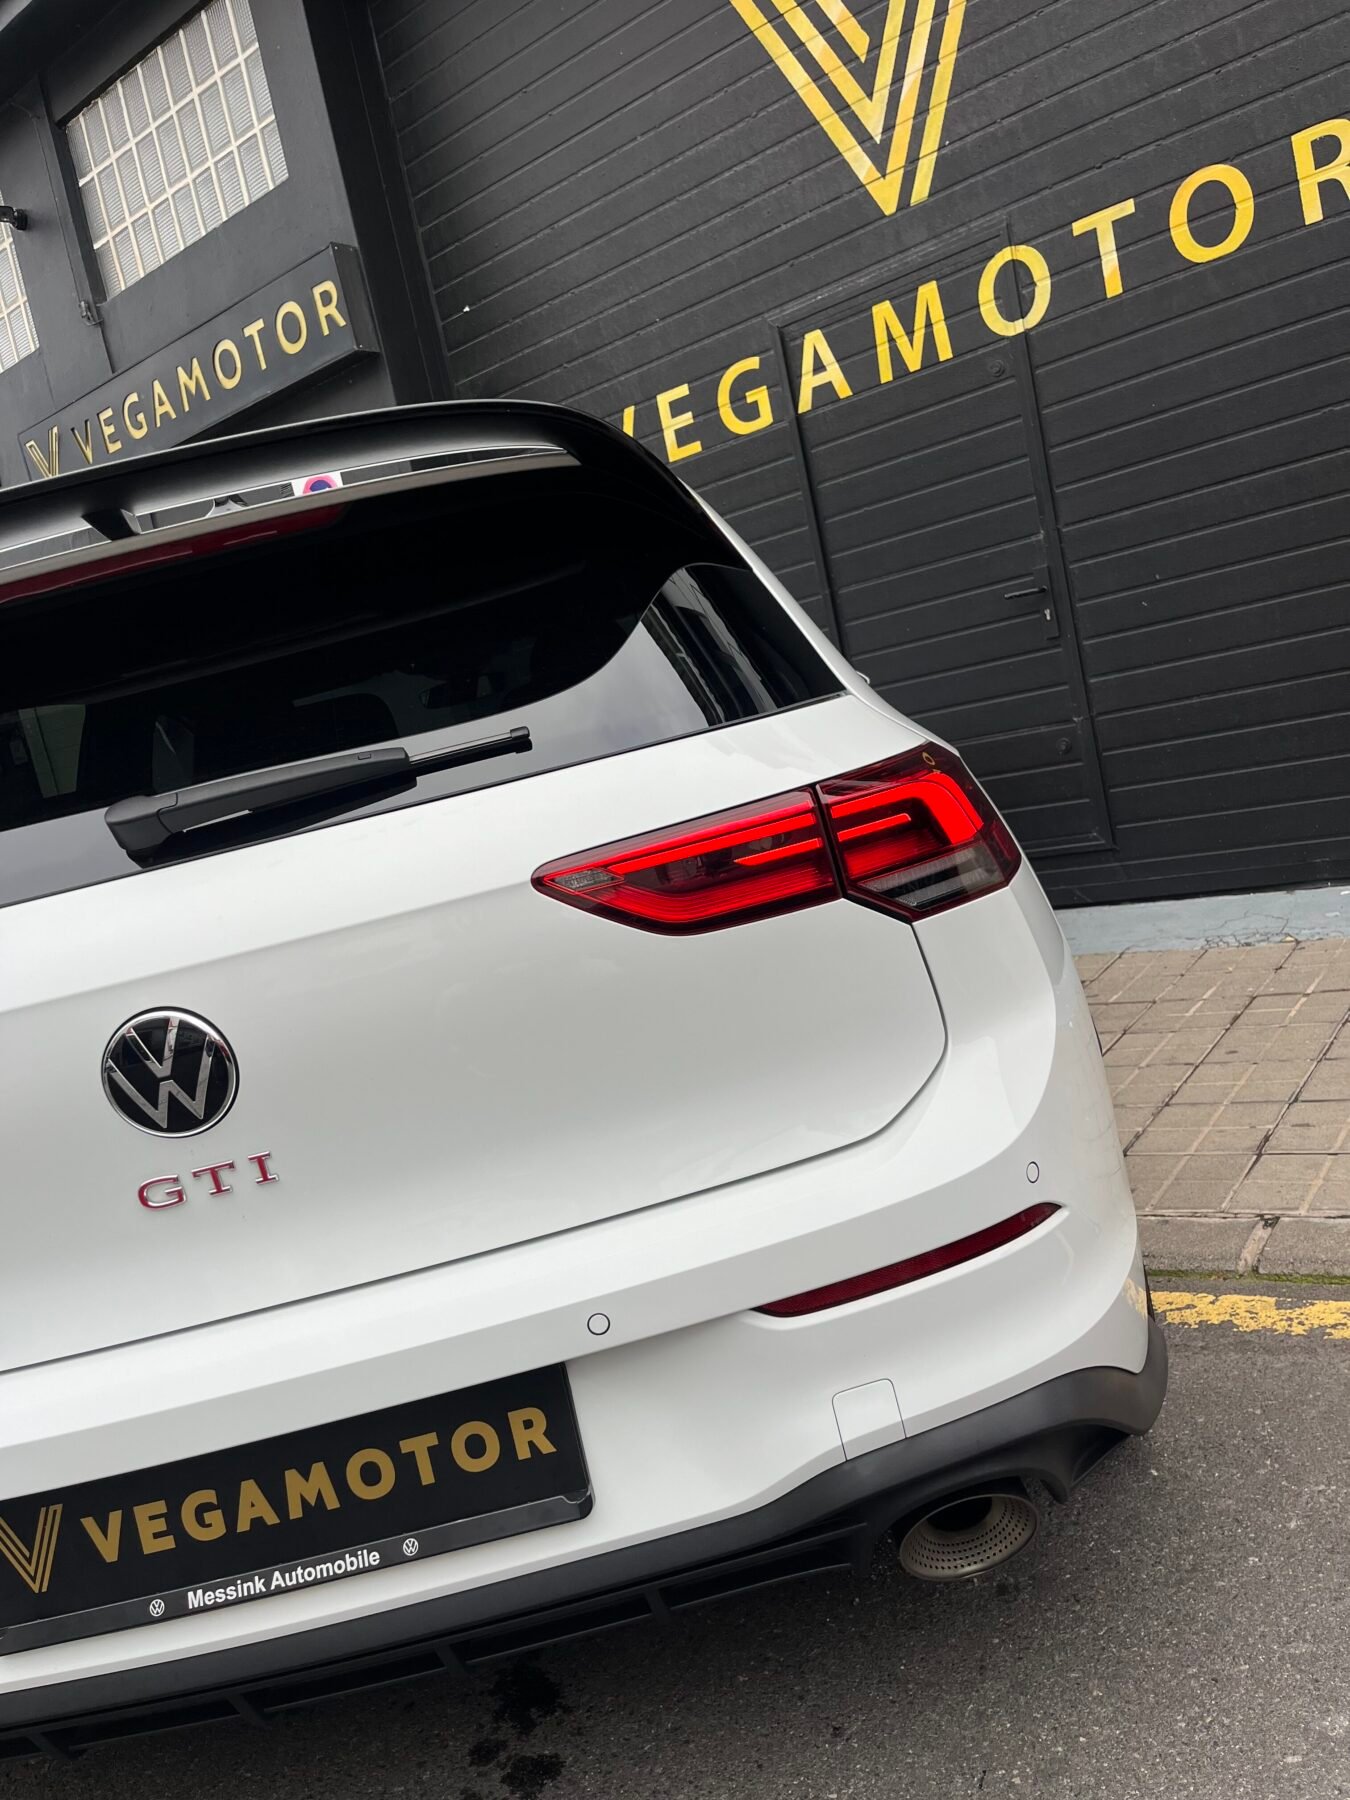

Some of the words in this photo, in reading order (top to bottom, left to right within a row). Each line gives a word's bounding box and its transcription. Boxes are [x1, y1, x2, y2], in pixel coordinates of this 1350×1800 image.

[70, 279, 348, 465] VEGAMOTOR
[137, 1151, 280, 1211] GTI
[79, 1407, 558, 1564] VEGAMOTOR
[186, 1575, 267, 1610] Messink
[270, 1549, 381, 1591] Automobile
